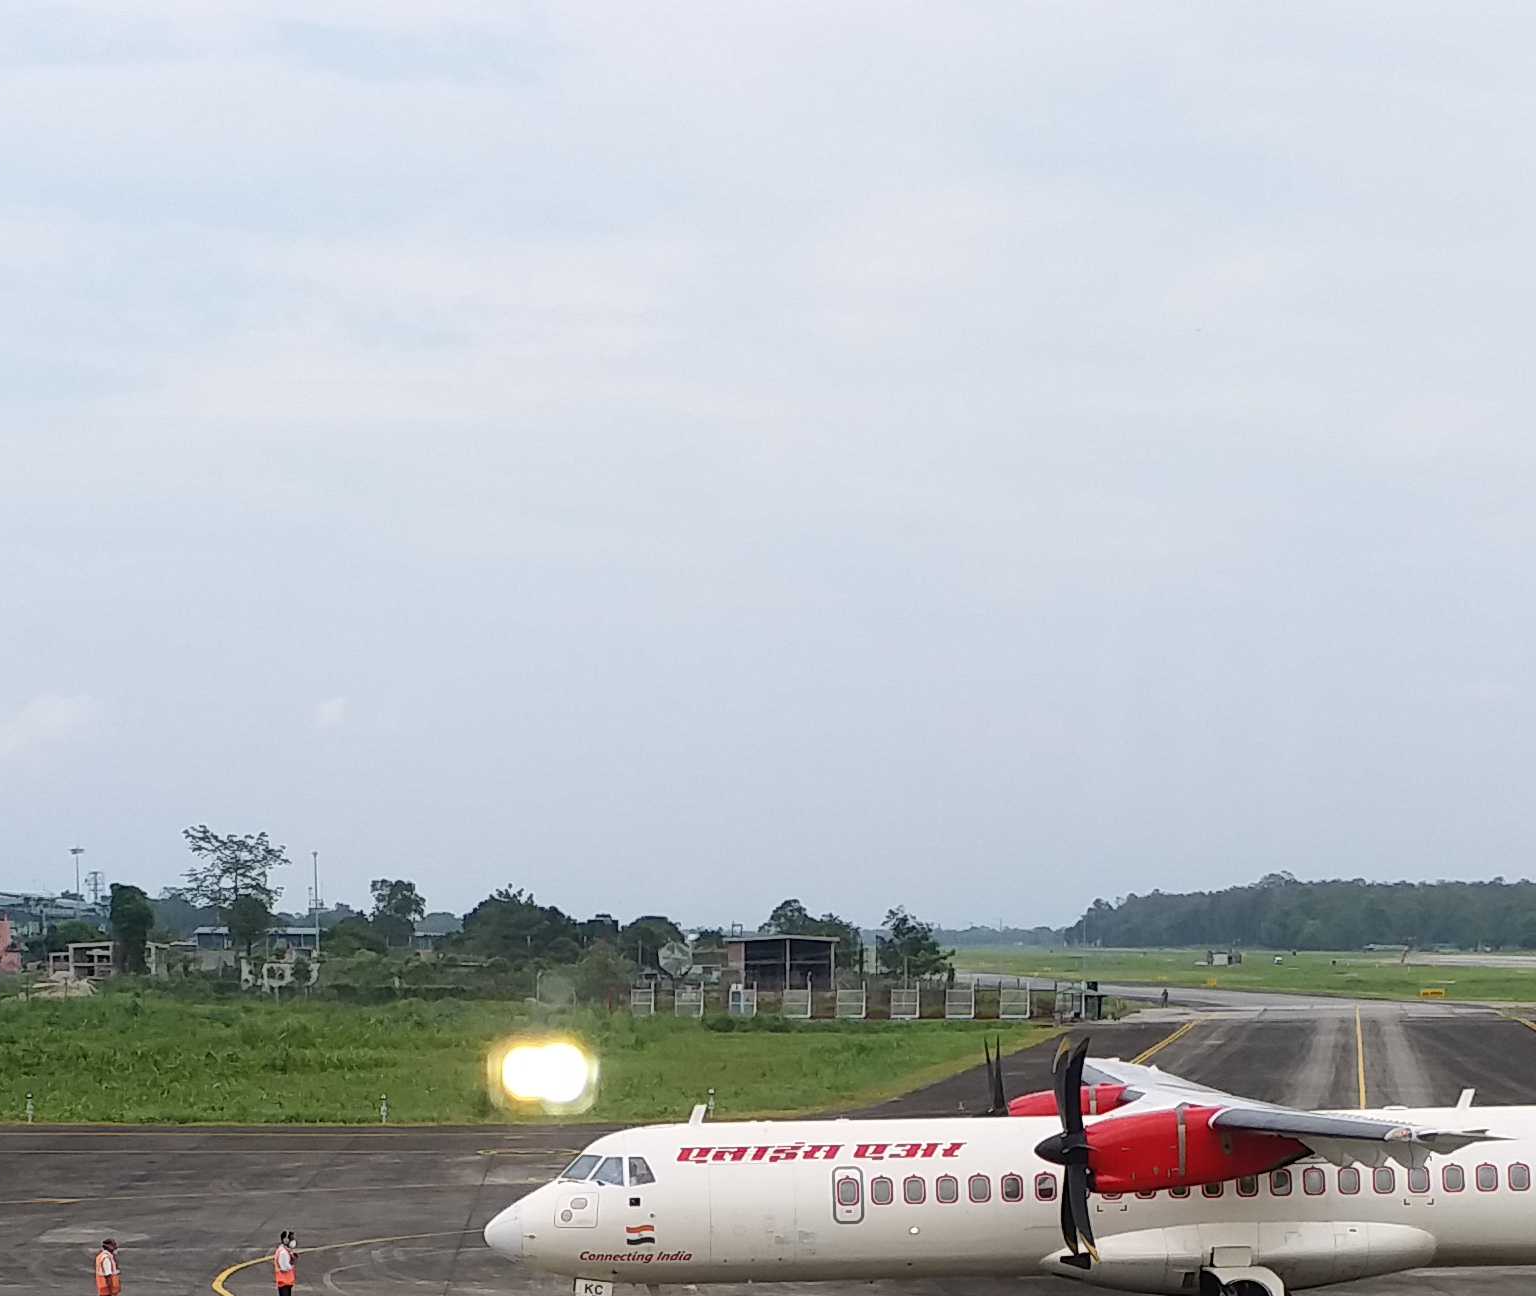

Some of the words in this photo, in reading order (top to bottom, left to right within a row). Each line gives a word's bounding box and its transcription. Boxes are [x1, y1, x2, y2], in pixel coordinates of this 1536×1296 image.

[852, 1142, 968, 1161] एअर
[579, 1250, 655, 1264] Connecting
[656, 1250, 693, 1262] India
[583, 1283, 604, 1296] KC
